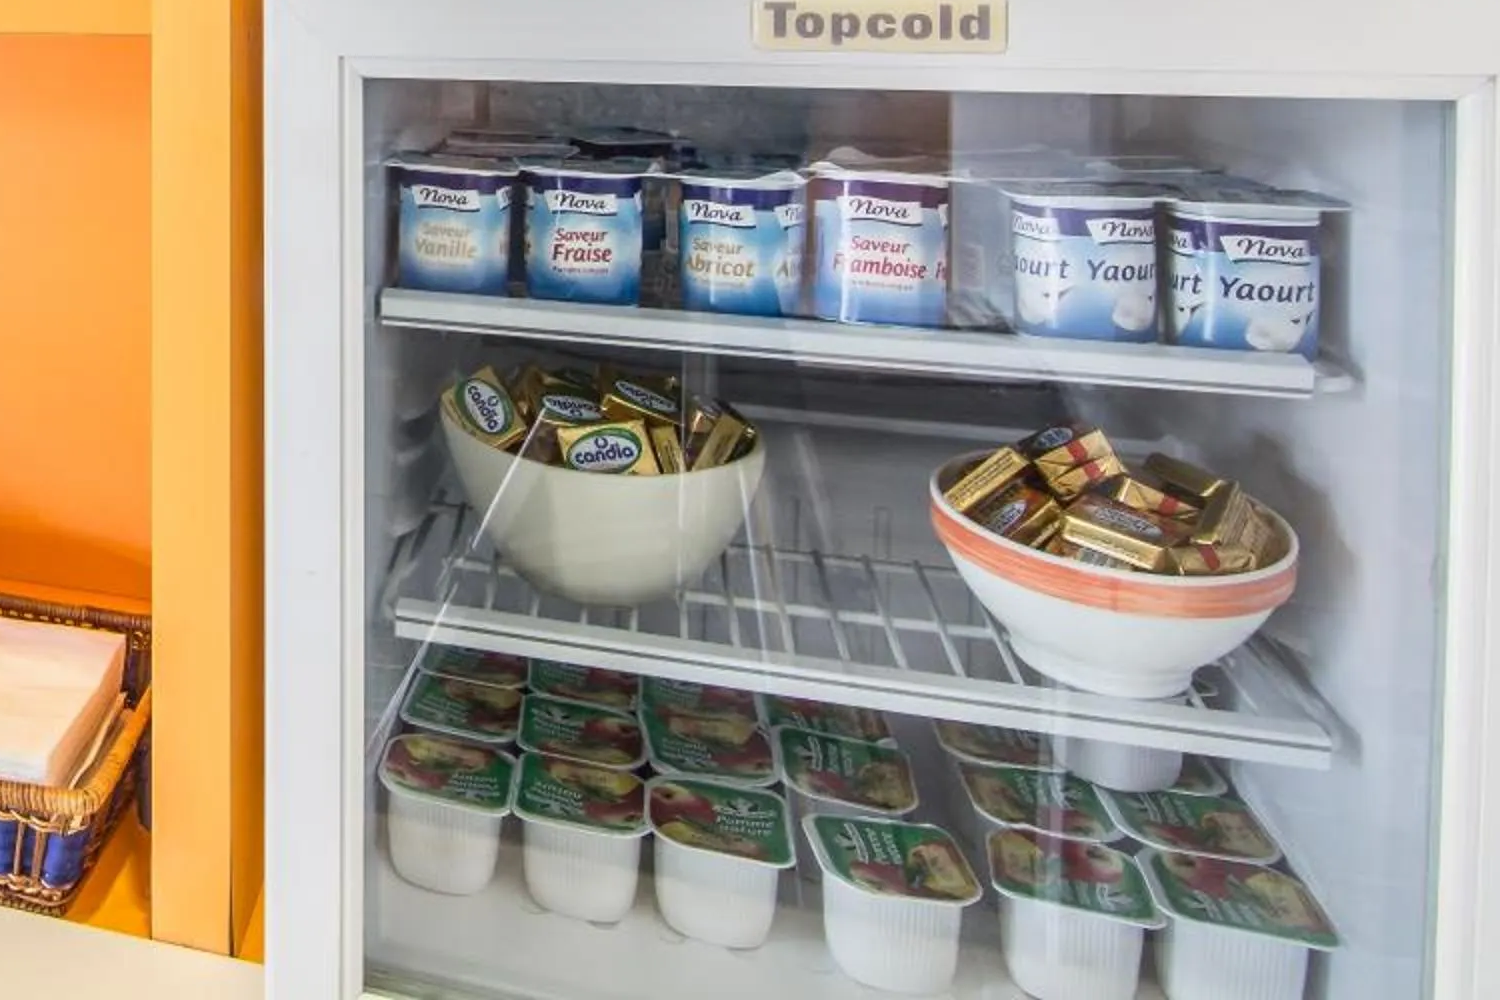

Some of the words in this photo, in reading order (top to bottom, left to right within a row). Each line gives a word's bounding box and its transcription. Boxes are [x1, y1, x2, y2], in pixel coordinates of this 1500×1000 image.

[764, 1, 990, 45] Topcold
[420, 187, 470, 205] Nova
[555, 193, 607, 209] Nova
[691, 202, 744, 221] Nova
[849, 198, 911, 218] Nova
[555, 227, 608, 242] Saveur
[851, 235, 911, 254] Saveur
[415, 239, 477, 259] Vanille
[552, 243, 612, 262] Fraise
[692, 238, 744, 254] Saveur
[1237, 238, 1306, 258] Nova
[833, 253, 927, 279] Famboise
[1015, 257, 1070, 279] ourt
[1087, 259, 1156, 281] Yaour
[1220, 276, 1315, 303] Yaourt
[467, 385, 499, 430] candia
[575, 443, 635, 464] candia
